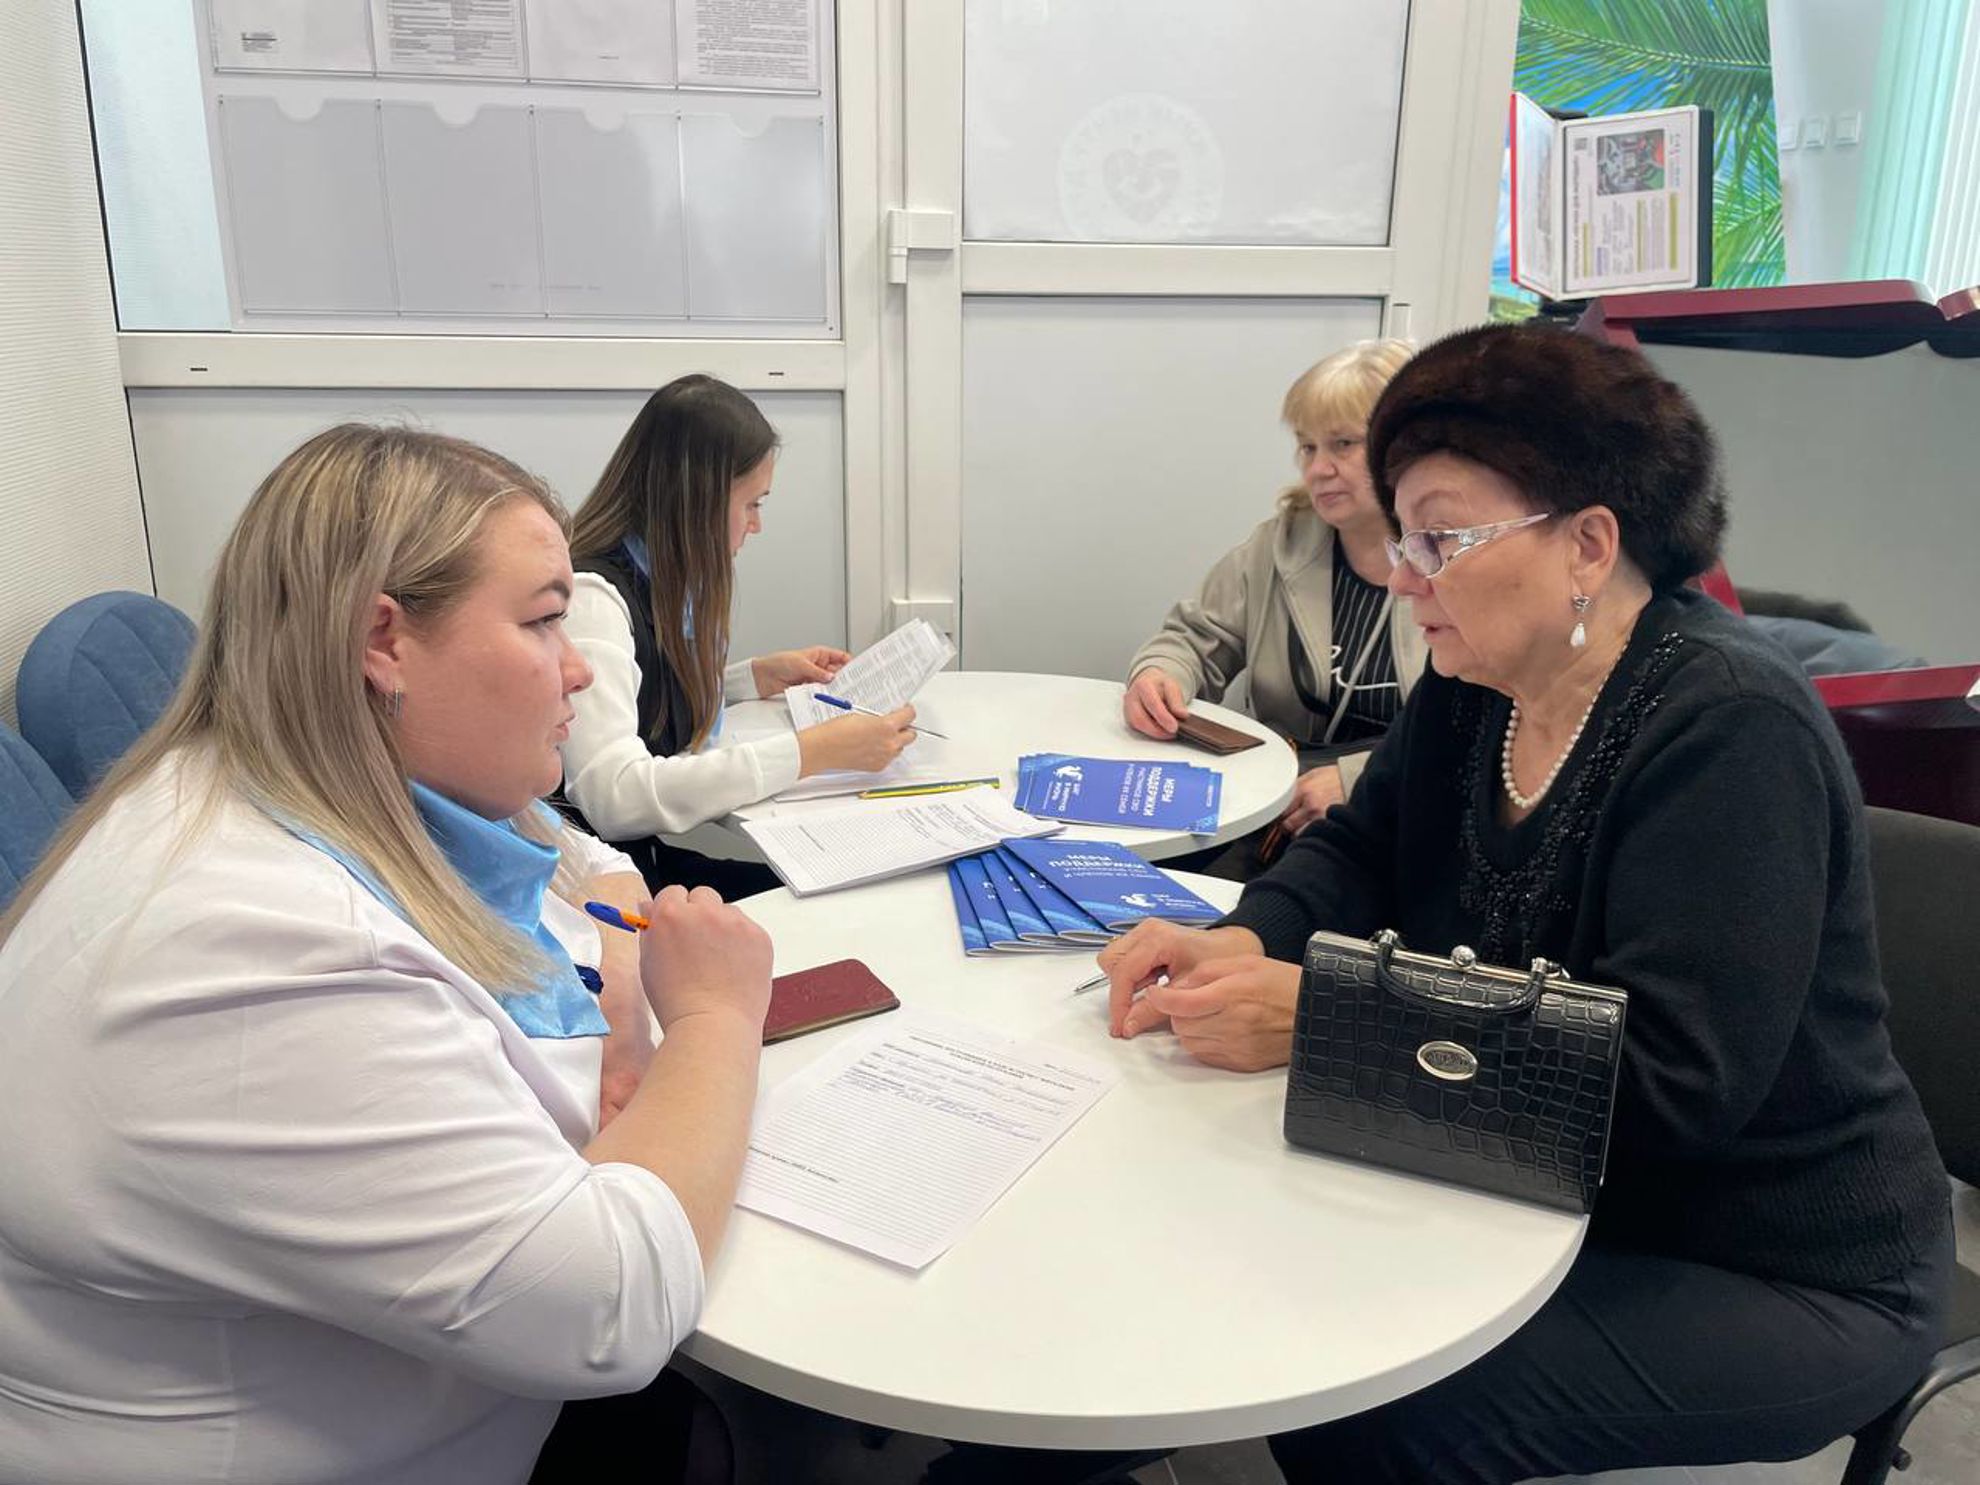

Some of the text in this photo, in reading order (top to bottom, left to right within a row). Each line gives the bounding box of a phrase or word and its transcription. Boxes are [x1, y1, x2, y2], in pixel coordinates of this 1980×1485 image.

[1142, 767, 1162, 816] ПОДДЕРЖКИ
[1161, 779, 1175, 802] МЕРЫ
[1048, 860, 1145, 869] ПОДДЕРЖКИ
